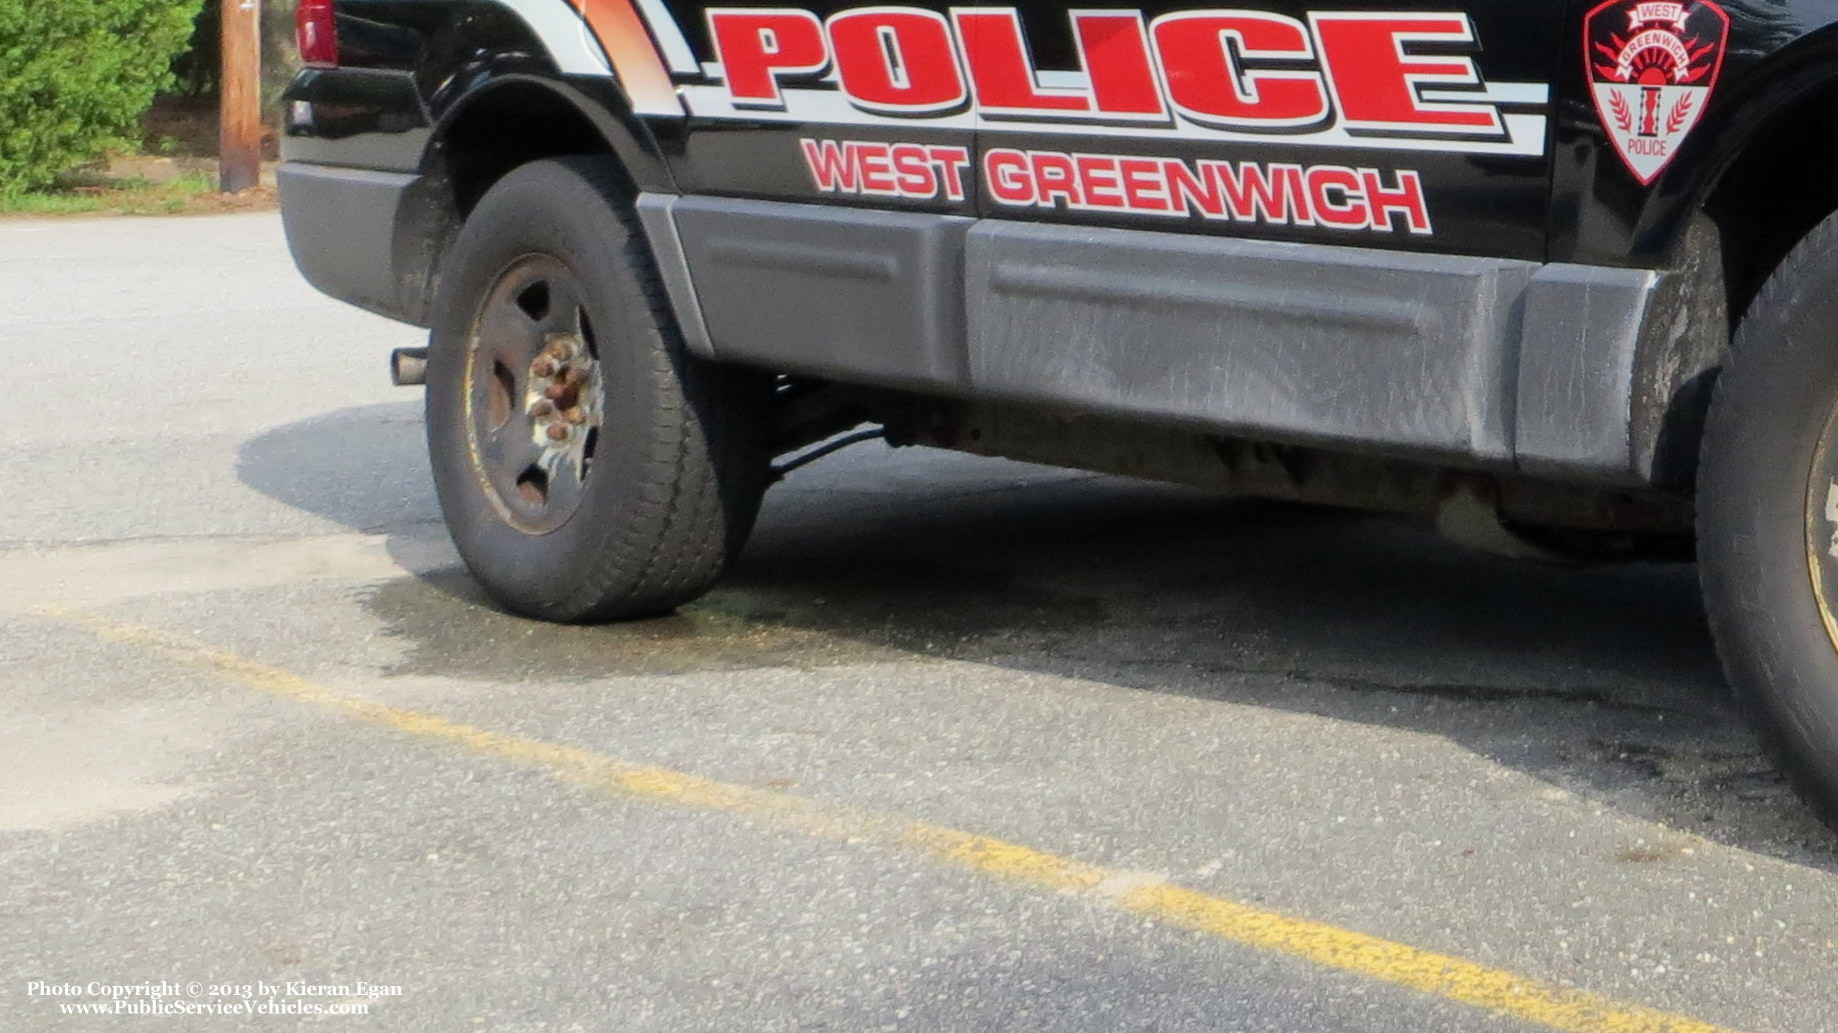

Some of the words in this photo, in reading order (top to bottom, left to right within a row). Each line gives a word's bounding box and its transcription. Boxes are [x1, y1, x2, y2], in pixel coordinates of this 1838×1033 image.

[1641, 4, 1678, 18] WEST
[1623, 34, 1687, 65] GREENWICH
[704, 6, 1512, 142] POLICE
[1627, 138, 1667, 156] POLICE
[801, 138, 969, 200] WEST
[985, 149, 1433, 236] GREENWICH
